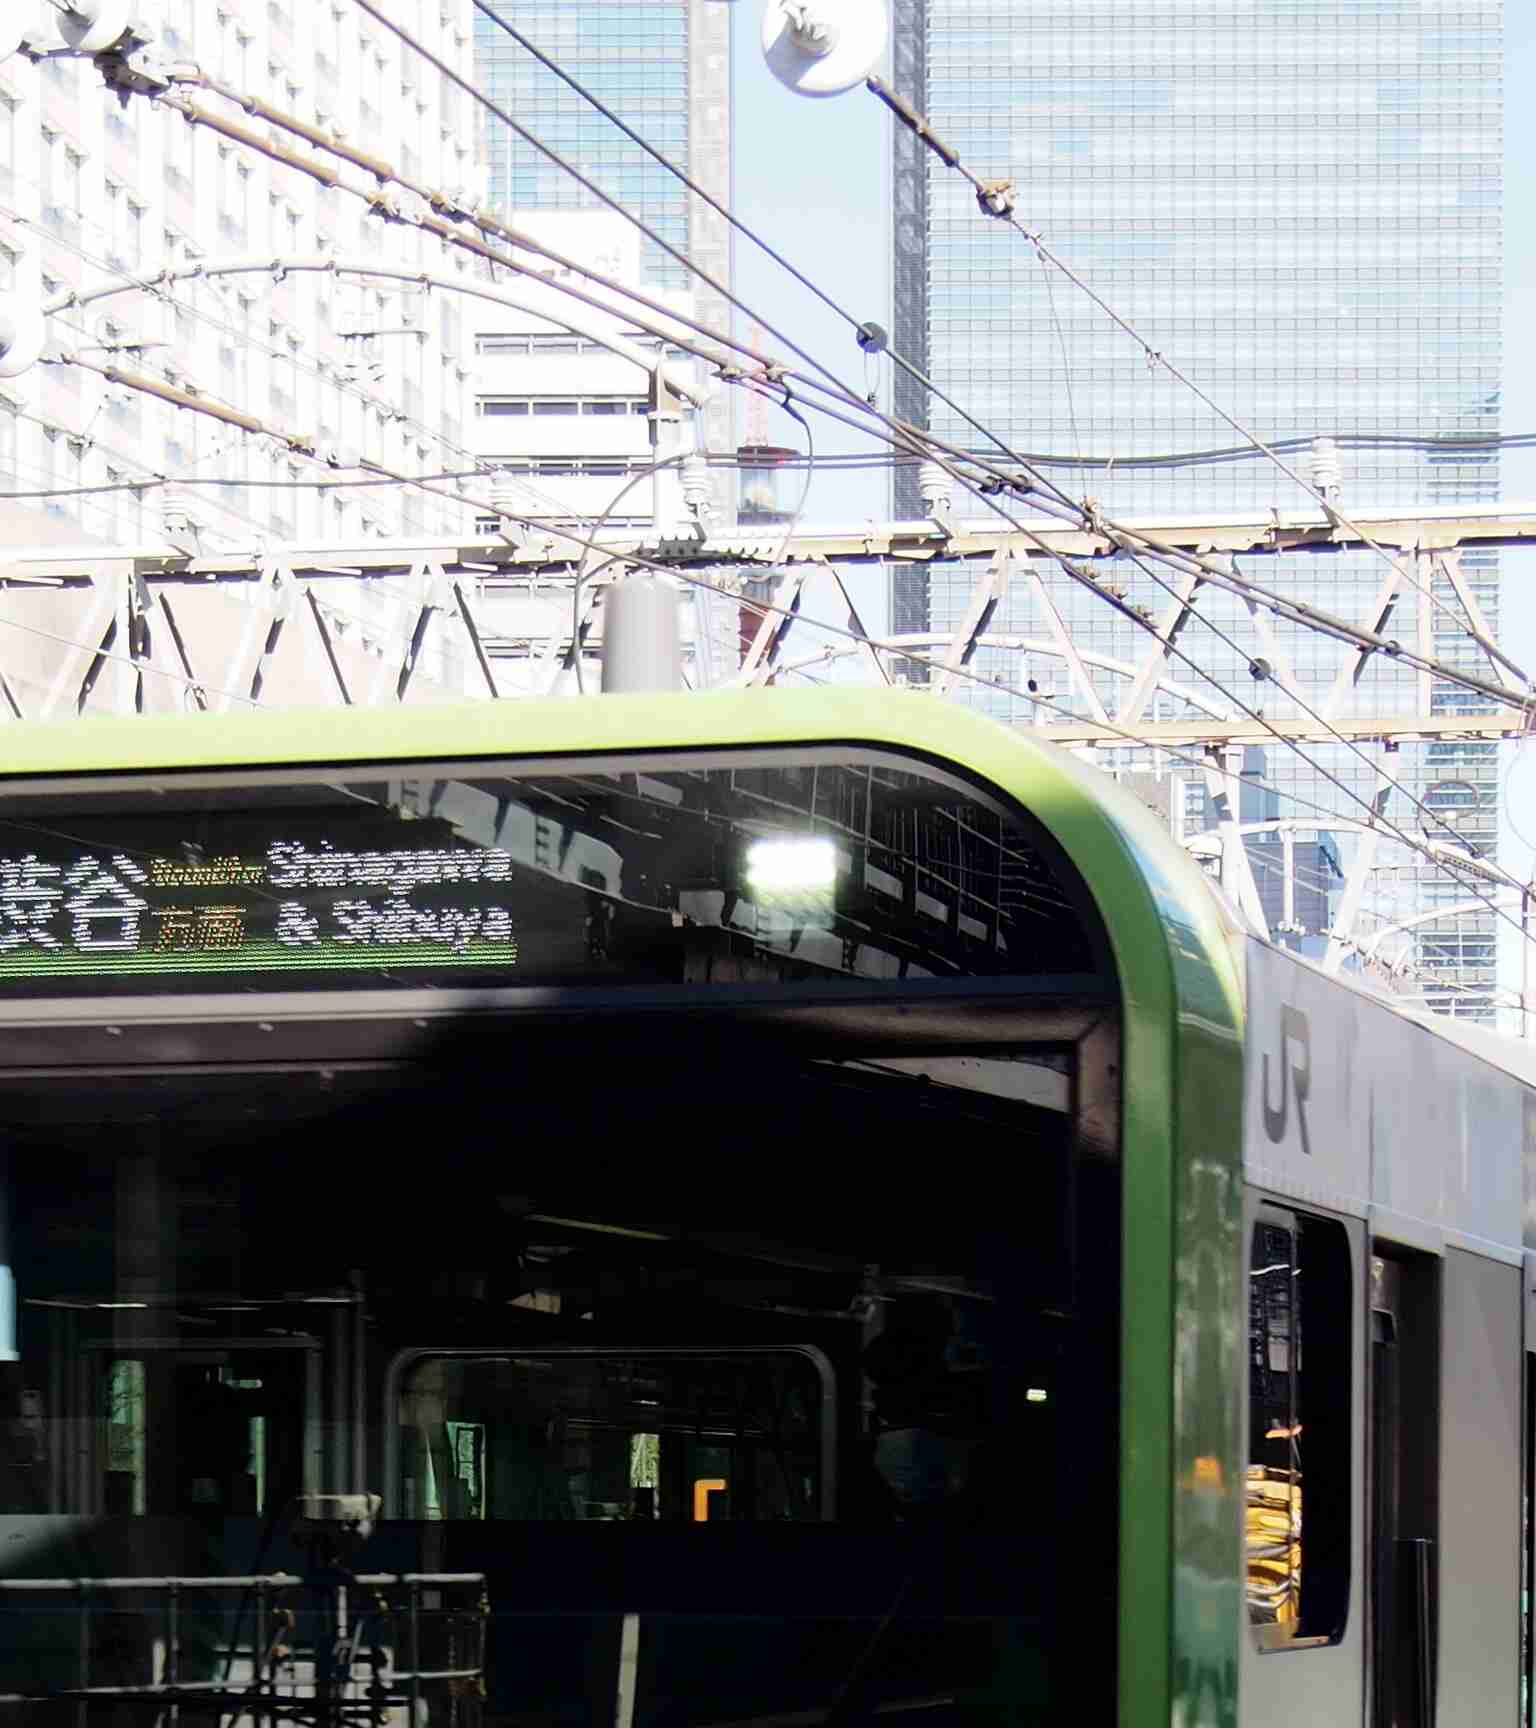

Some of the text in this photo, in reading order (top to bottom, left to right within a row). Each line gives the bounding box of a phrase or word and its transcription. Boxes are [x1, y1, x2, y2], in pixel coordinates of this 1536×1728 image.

[267, 840, 512, 895] Shinagawa
[275, 899, 512, 954] & Shibuya
[1262, 1001, 1311, 1157] JR
